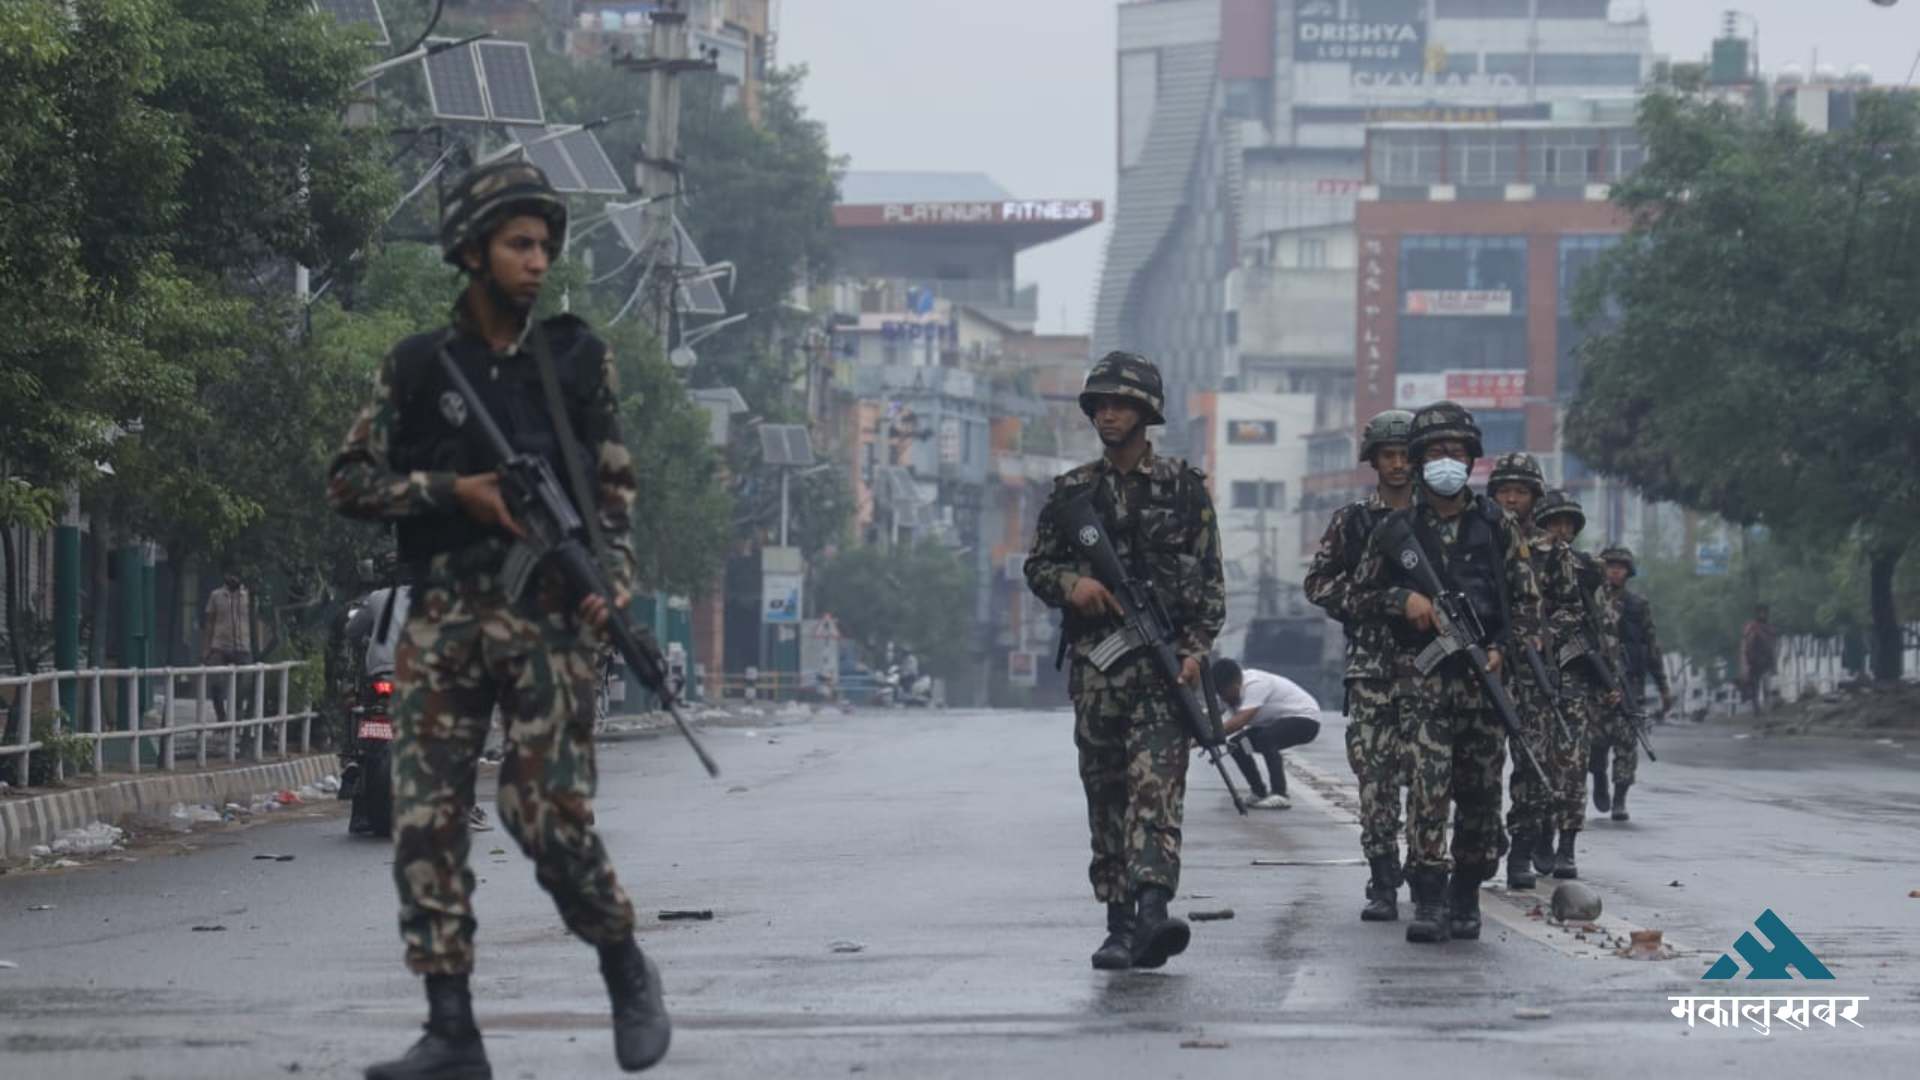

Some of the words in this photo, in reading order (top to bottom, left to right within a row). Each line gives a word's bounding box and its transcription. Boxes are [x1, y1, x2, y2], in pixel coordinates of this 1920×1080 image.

[1299, 23, 1417, 42] DRISHYA
[1318, 45, 1401, 59] LOUNGE
[882, 204, 991, 222] PLATINUM
[1001, 201, 1094, 220] FITNESS
